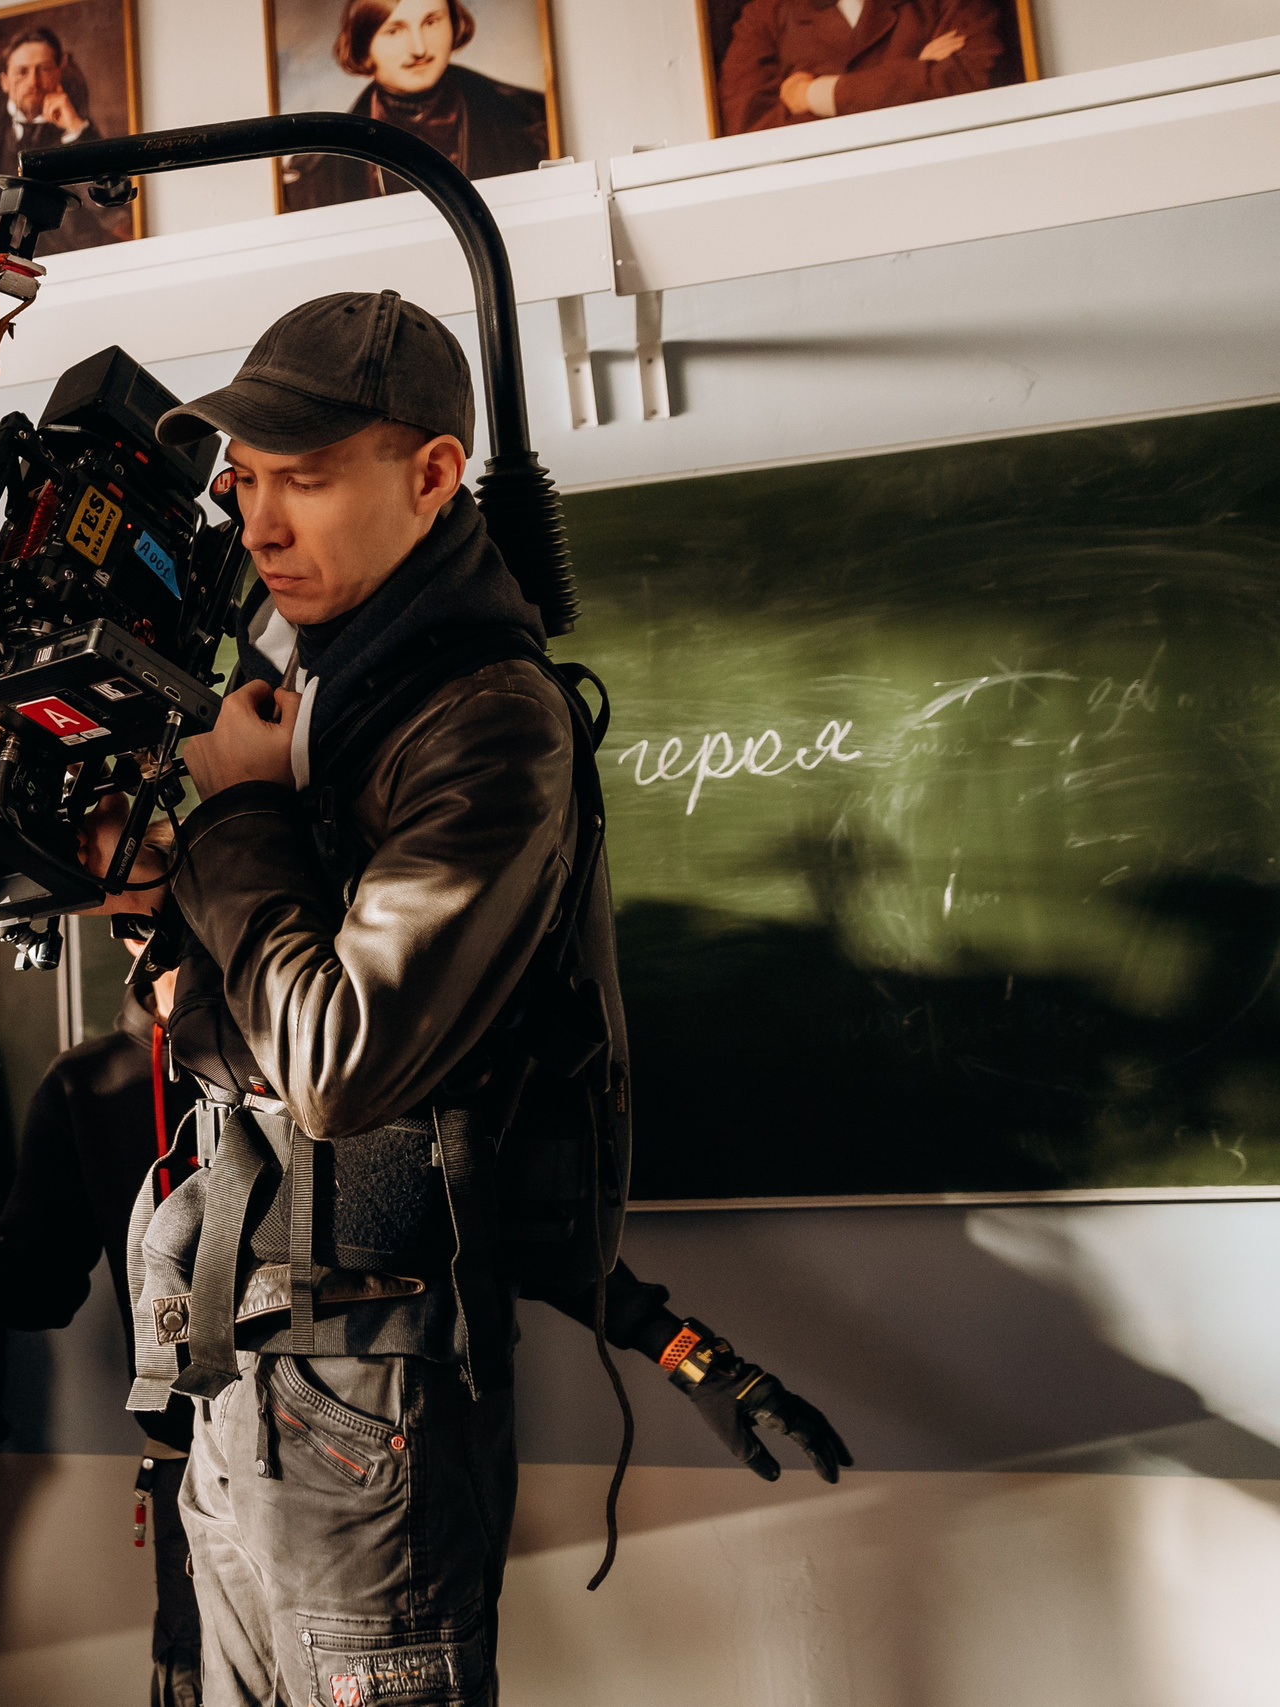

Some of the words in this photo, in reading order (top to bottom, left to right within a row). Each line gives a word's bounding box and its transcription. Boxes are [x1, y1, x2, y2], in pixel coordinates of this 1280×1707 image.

[73, 493, 105, 548] YES
[98, 507, 116, 538] heavy
[43, 708, 80, 729] A
[117, 855, 130, 877] RENTAL
